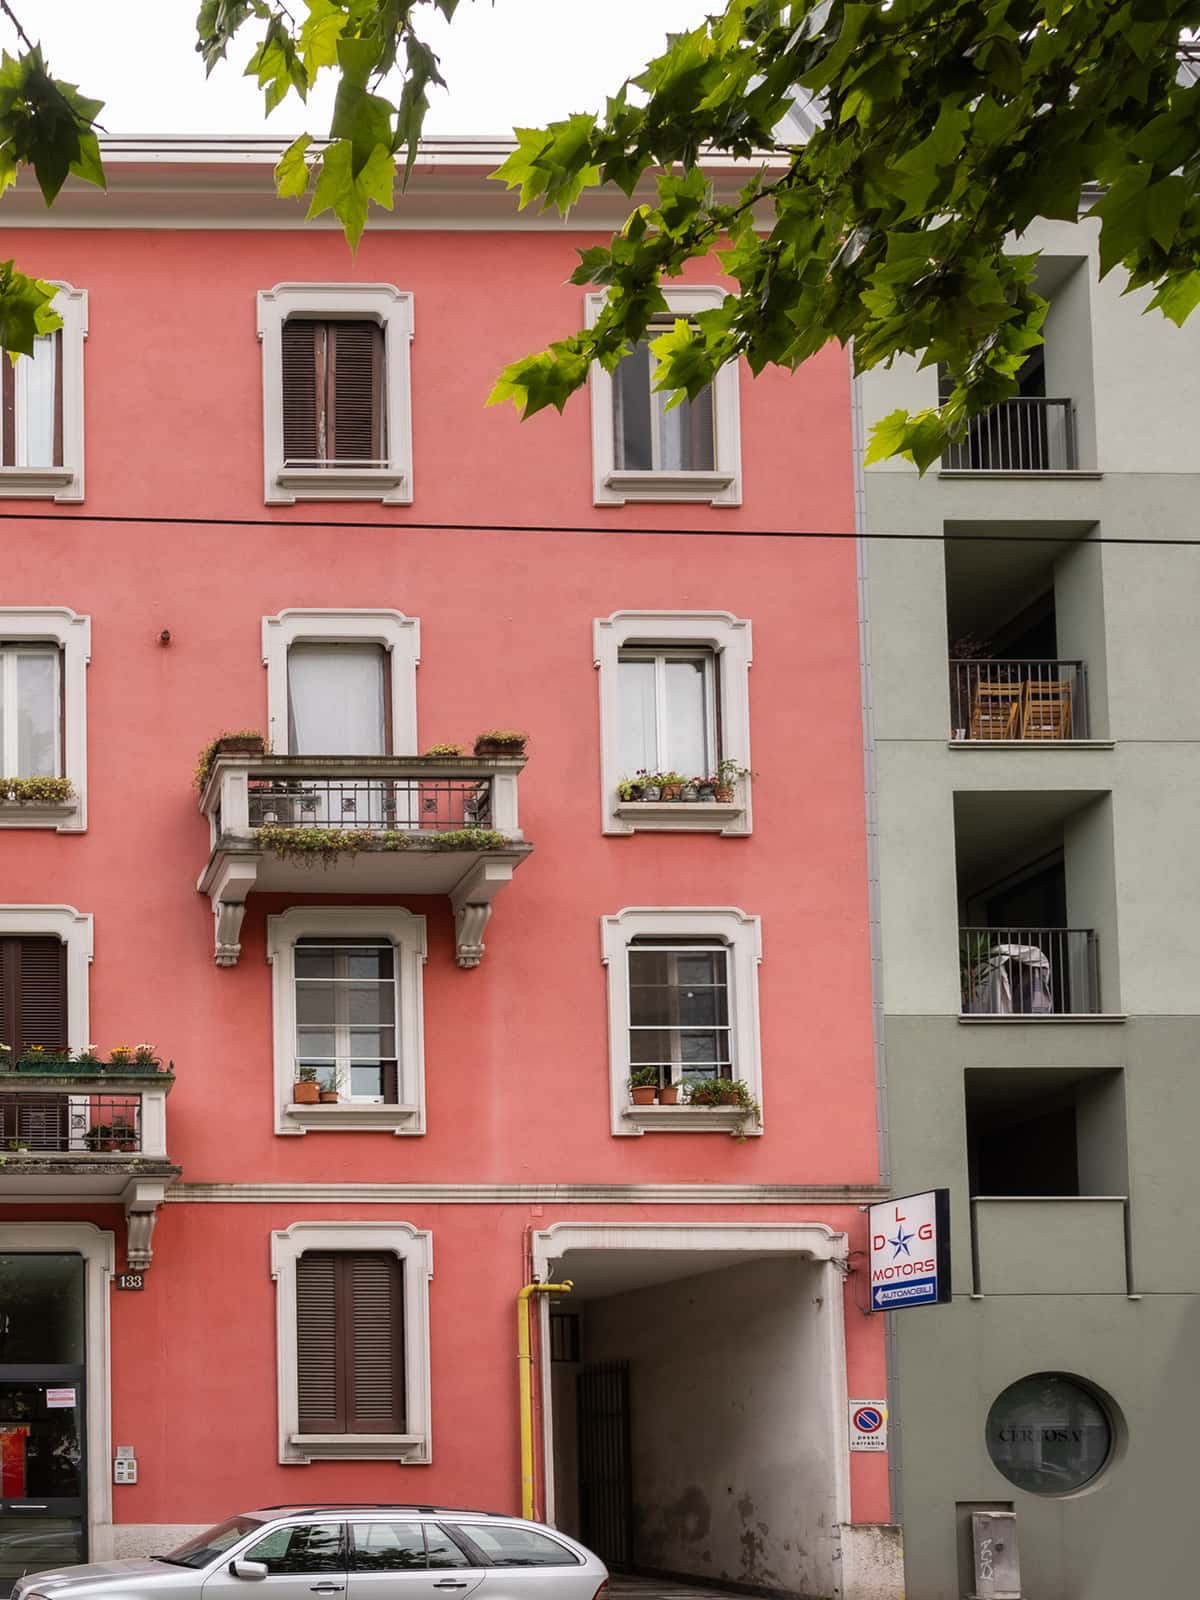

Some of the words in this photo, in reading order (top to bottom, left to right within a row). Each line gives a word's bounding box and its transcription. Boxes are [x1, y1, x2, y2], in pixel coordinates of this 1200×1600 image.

[895, 1207, 906, 1222] L
[873, 1235, 886, 1251] D
[918, 1223, 933, 1241] G
[872, 1258, 935, 1281] MOTORS
[120, 1275, 142, 1288] 133
[882, 1285, 932, 1299] AUTOMOBILI
